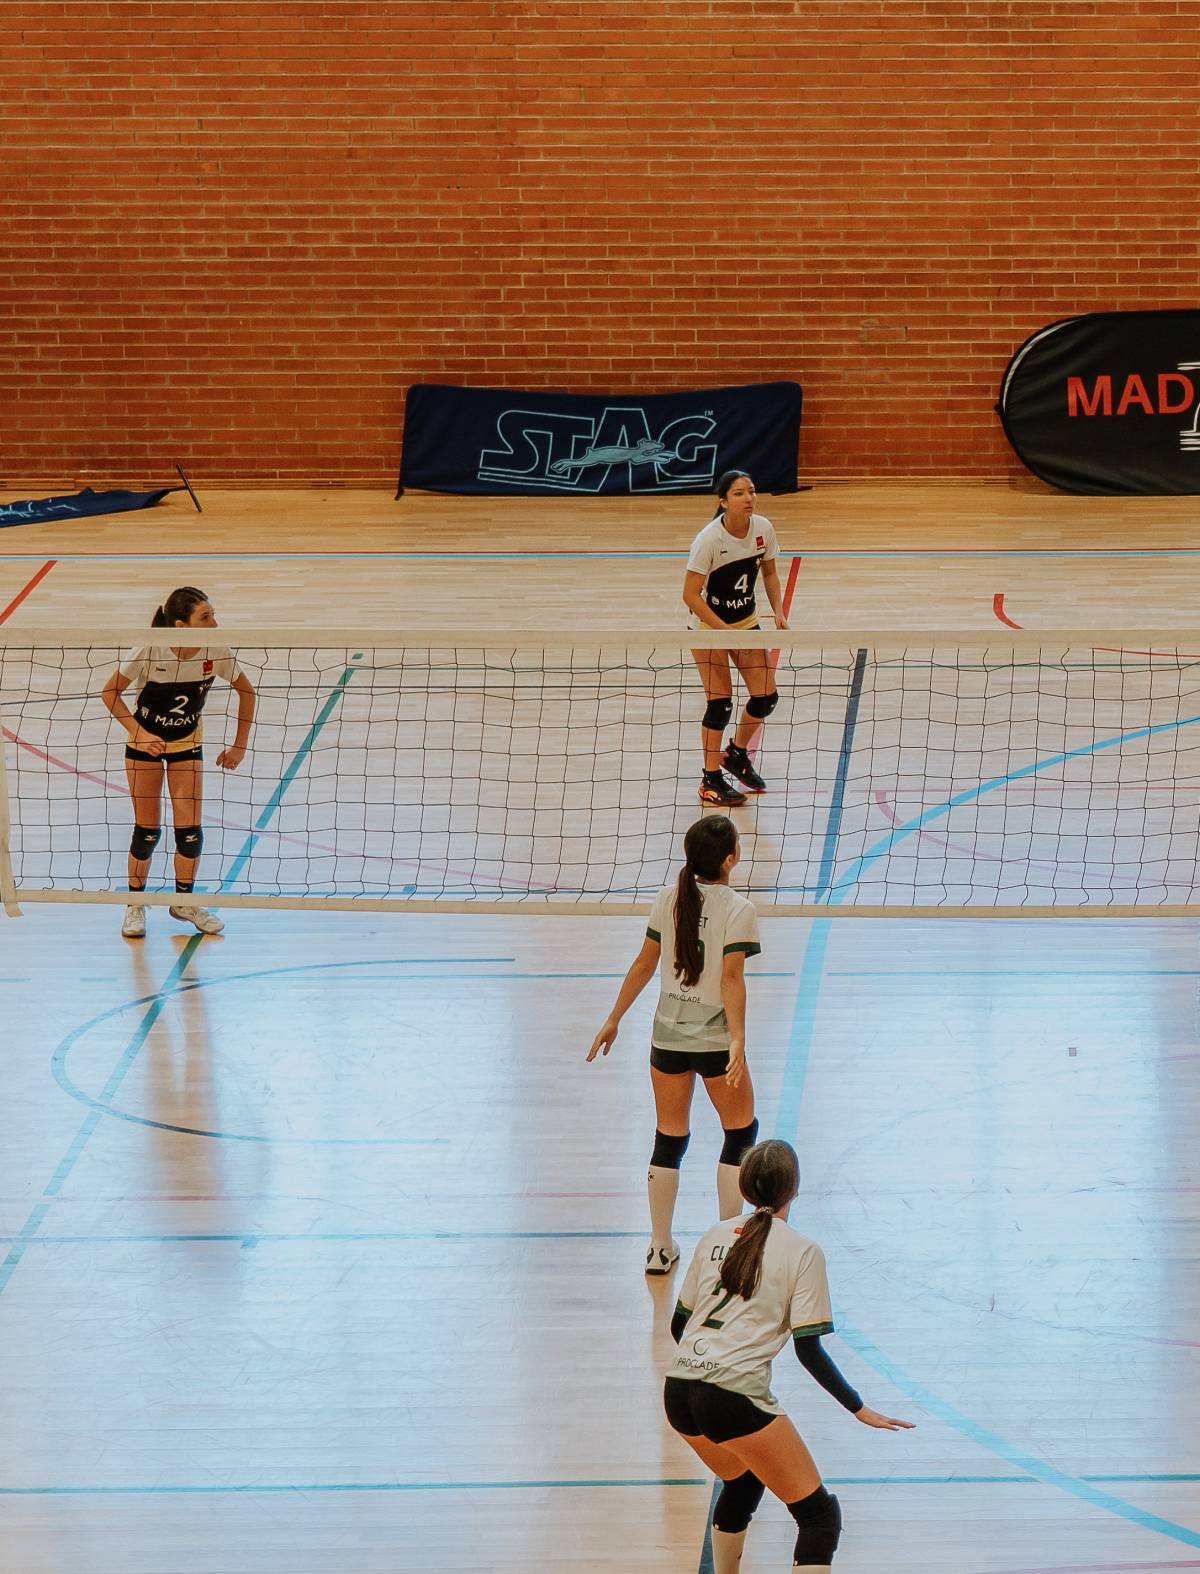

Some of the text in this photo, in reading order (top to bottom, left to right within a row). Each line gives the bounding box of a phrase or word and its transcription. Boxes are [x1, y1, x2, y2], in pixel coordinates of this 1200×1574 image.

[1066, 372, 1195, 417] MAD
[477, 407, 719, 492] STAG
[734, 574, 749, 594] 4
[169, 695, 190, 715] 2
[155, 713, 199, 727] MADRI
[677, 1357, 720, 1371] PROCLADE
